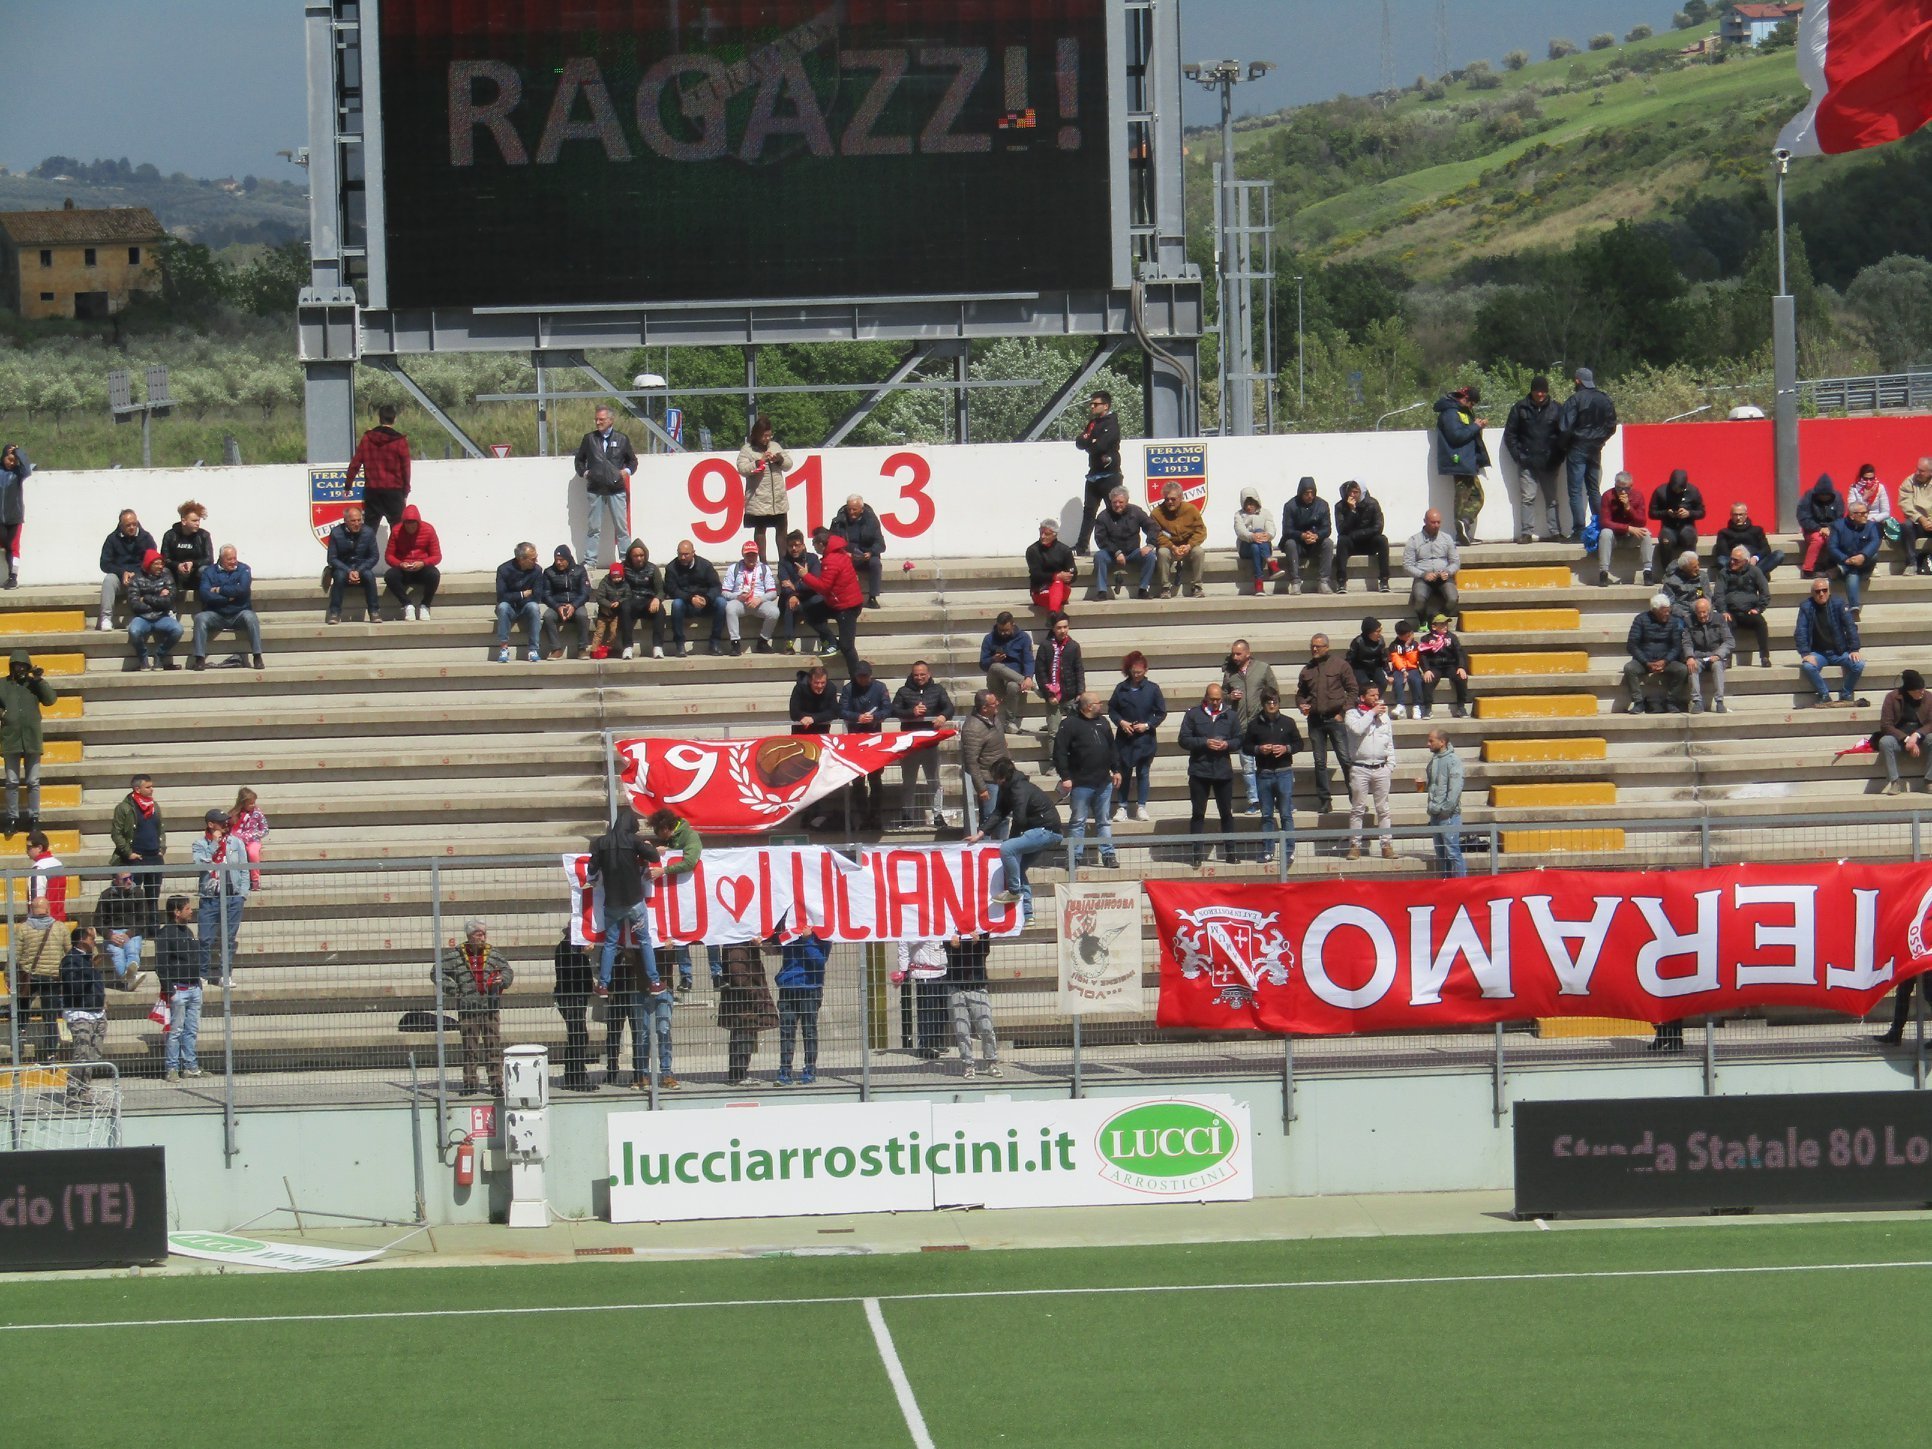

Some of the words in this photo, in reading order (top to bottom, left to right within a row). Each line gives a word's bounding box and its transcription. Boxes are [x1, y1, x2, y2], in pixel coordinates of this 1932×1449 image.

[1148, 446, 1204, 455] TERAMO
[1151, 456, 1201, 464] CALCIO
[1164, 465, 1190, 473] 1913
[1199, 866, 1215, 878] 12
[758, 846, 1017, 941] LUCIANO
[1243, 911, 1258, 920] EAT
[1301, 883, 1896, 1011] TERAMO
[1109, 1119, 1224, 1160] LUCCI
[1687, 1126, 1821, 1171] Statale
[1828, 1126, 1876, 1168] 80
[1884, 1124, 1932, 1167] Lo
[1110, 1166, 1227, 1191] ARROSTICINI
[0, 1184, 54, 1226] cio
[62, 1181, 136, 1231] (TE)
